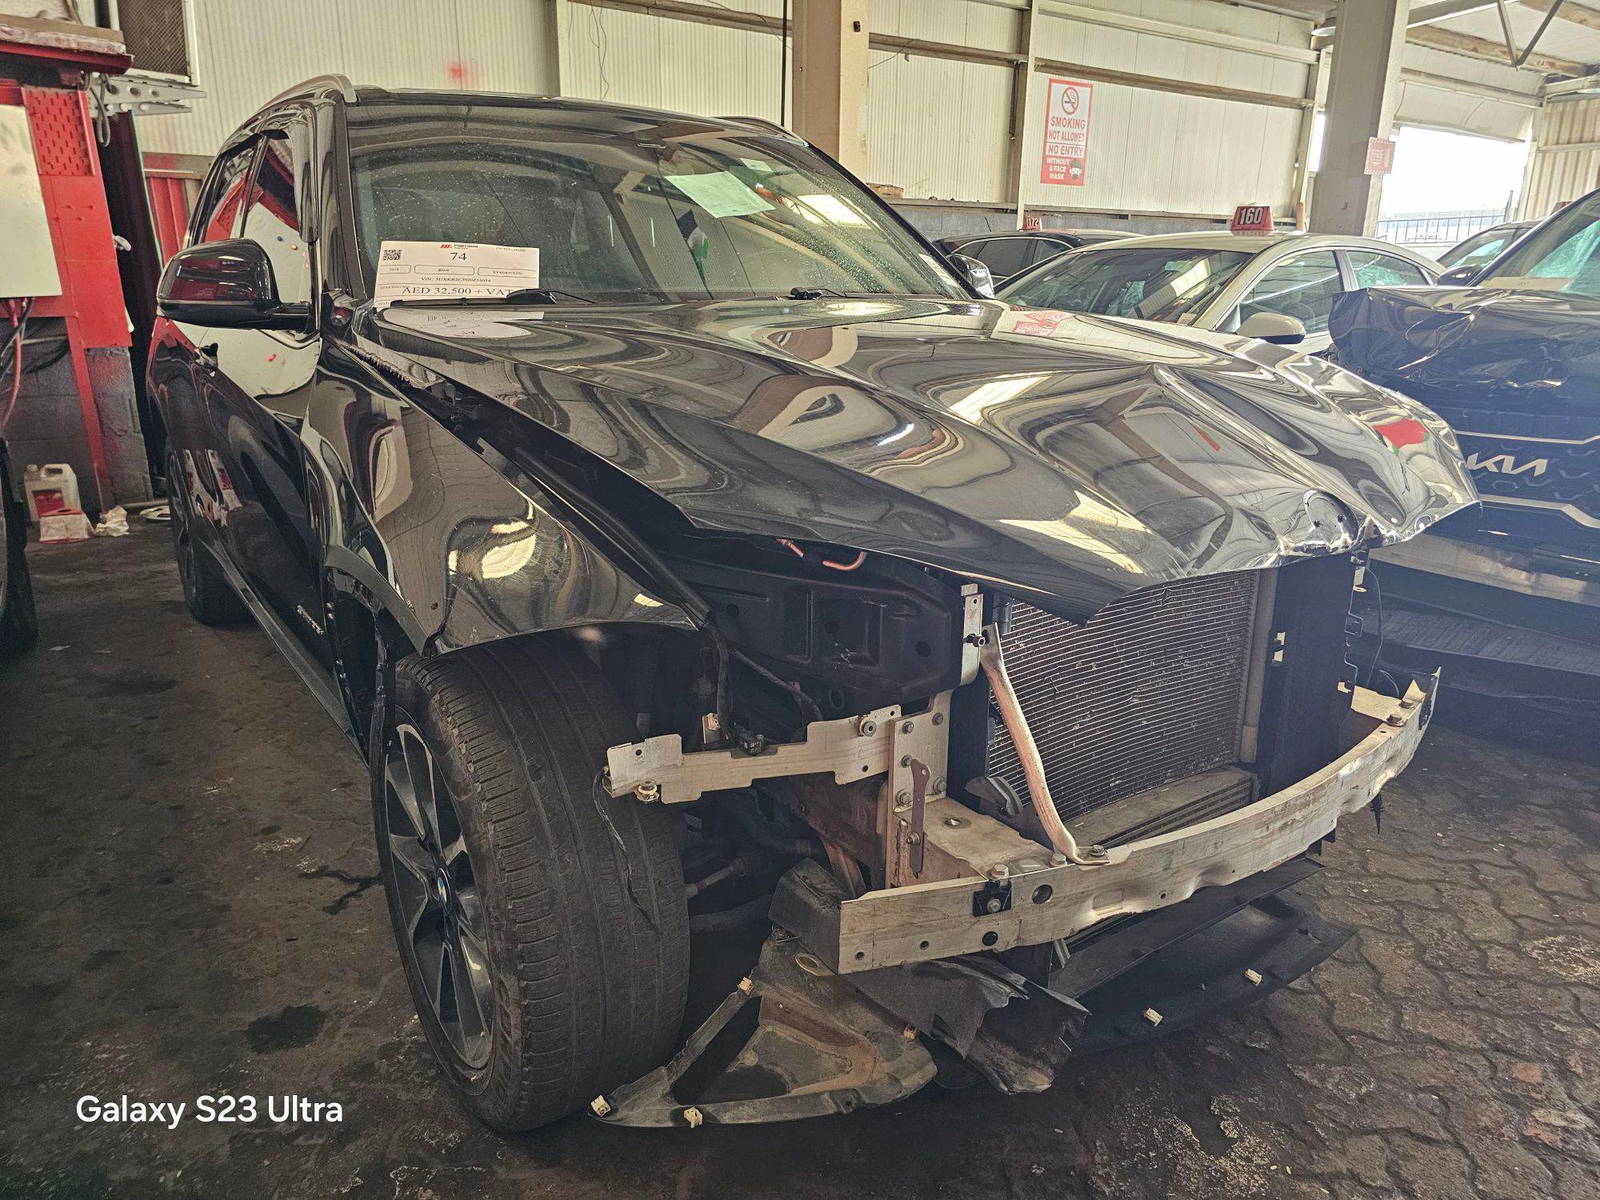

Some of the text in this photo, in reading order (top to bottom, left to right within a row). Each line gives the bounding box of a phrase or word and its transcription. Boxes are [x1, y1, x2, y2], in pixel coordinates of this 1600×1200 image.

[1050, 116, 1086, 129] SMOKING
[1049, 129, 1060, 140] NOT
[1048, 144, 1083, 156] NO ENTRY
[1240, 207, 1263, 225] 160
[450, 252, 467, 262] 74
[402, 287, 431, 295] AED
[1466, 452, 1548, 477] KIA
